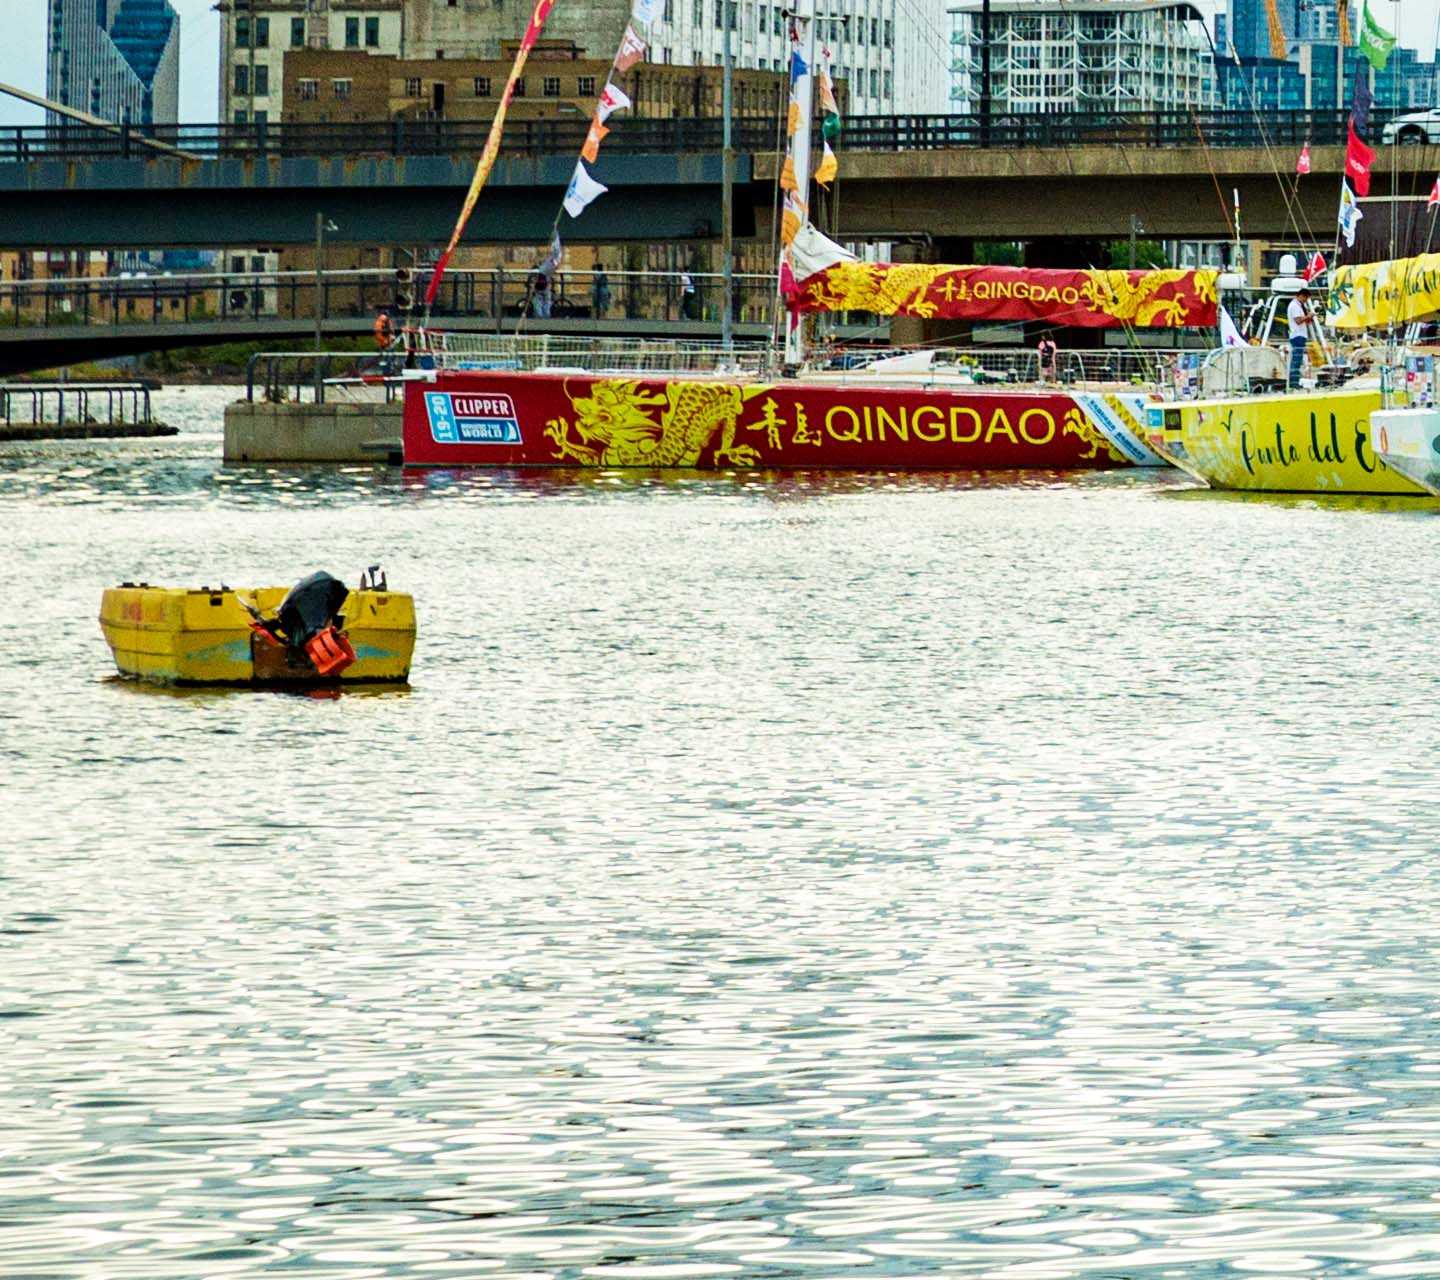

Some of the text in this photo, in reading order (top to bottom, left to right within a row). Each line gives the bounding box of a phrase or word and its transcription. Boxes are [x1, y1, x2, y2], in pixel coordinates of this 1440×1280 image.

[973, 280, 1079, 305] QINGDAO
[454, 398, 510, 416] CLIPPER
[462, 427, 503, 439] WORLD
[824, 404, 1056, 445] QINGDAO
[1308, 411, 1346, 464] del
